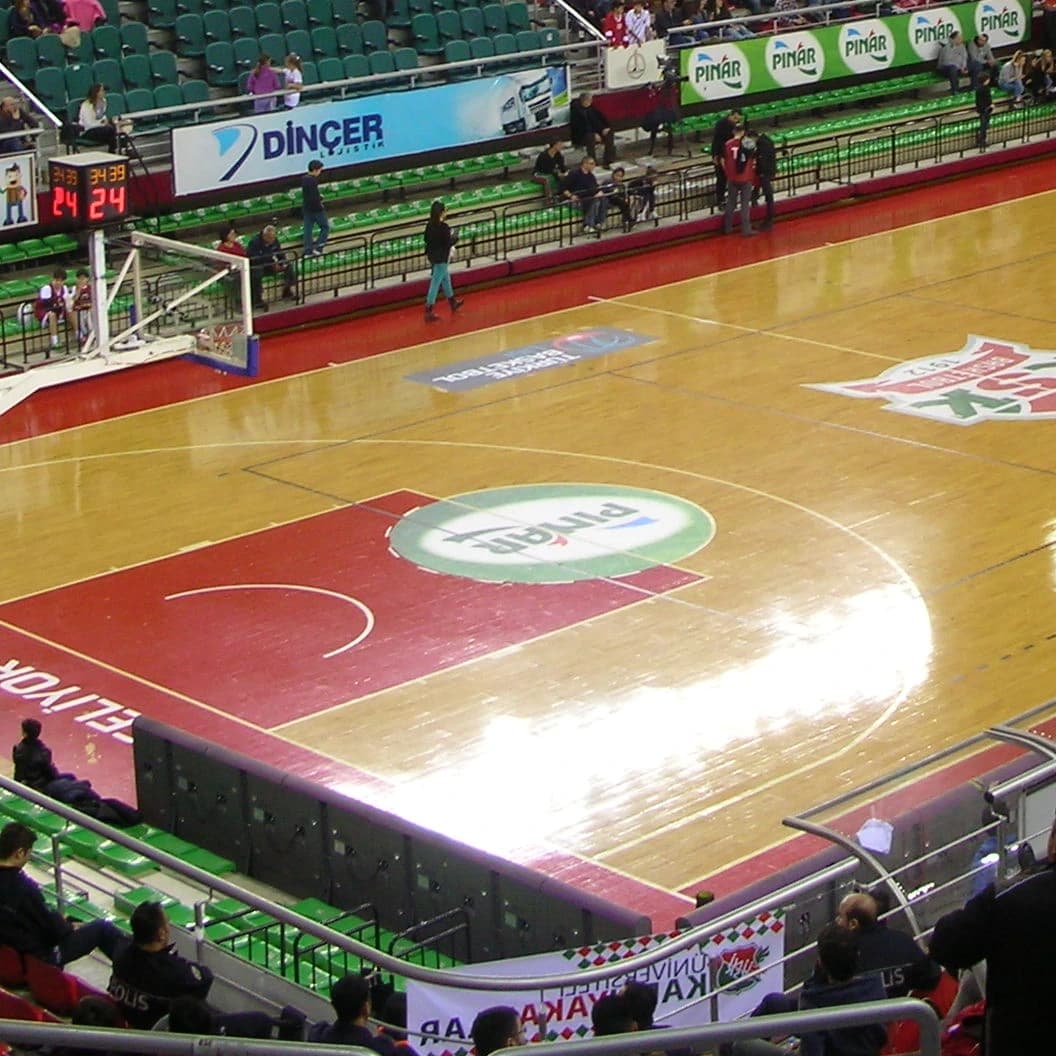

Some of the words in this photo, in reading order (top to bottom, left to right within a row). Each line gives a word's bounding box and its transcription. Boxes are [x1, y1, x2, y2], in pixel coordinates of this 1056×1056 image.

[980, 10, 1019, 32] PINAR
[845, 34, 888, 57] PINAR
[914, 22, 954, 45] PINAR
[695, 59, 741, 83] PINAR
[772, 47, 817, 71] PINAR
[263, 113, 384, 160] DİNÇER
[53, 186, 78, 218] 24
[89, 186, 125, 219] 24
[431, 348, 565, 383] BASKETBOL
[903, 357, 961, 376] 1912
[472, 502, 640, 555] PINAR
